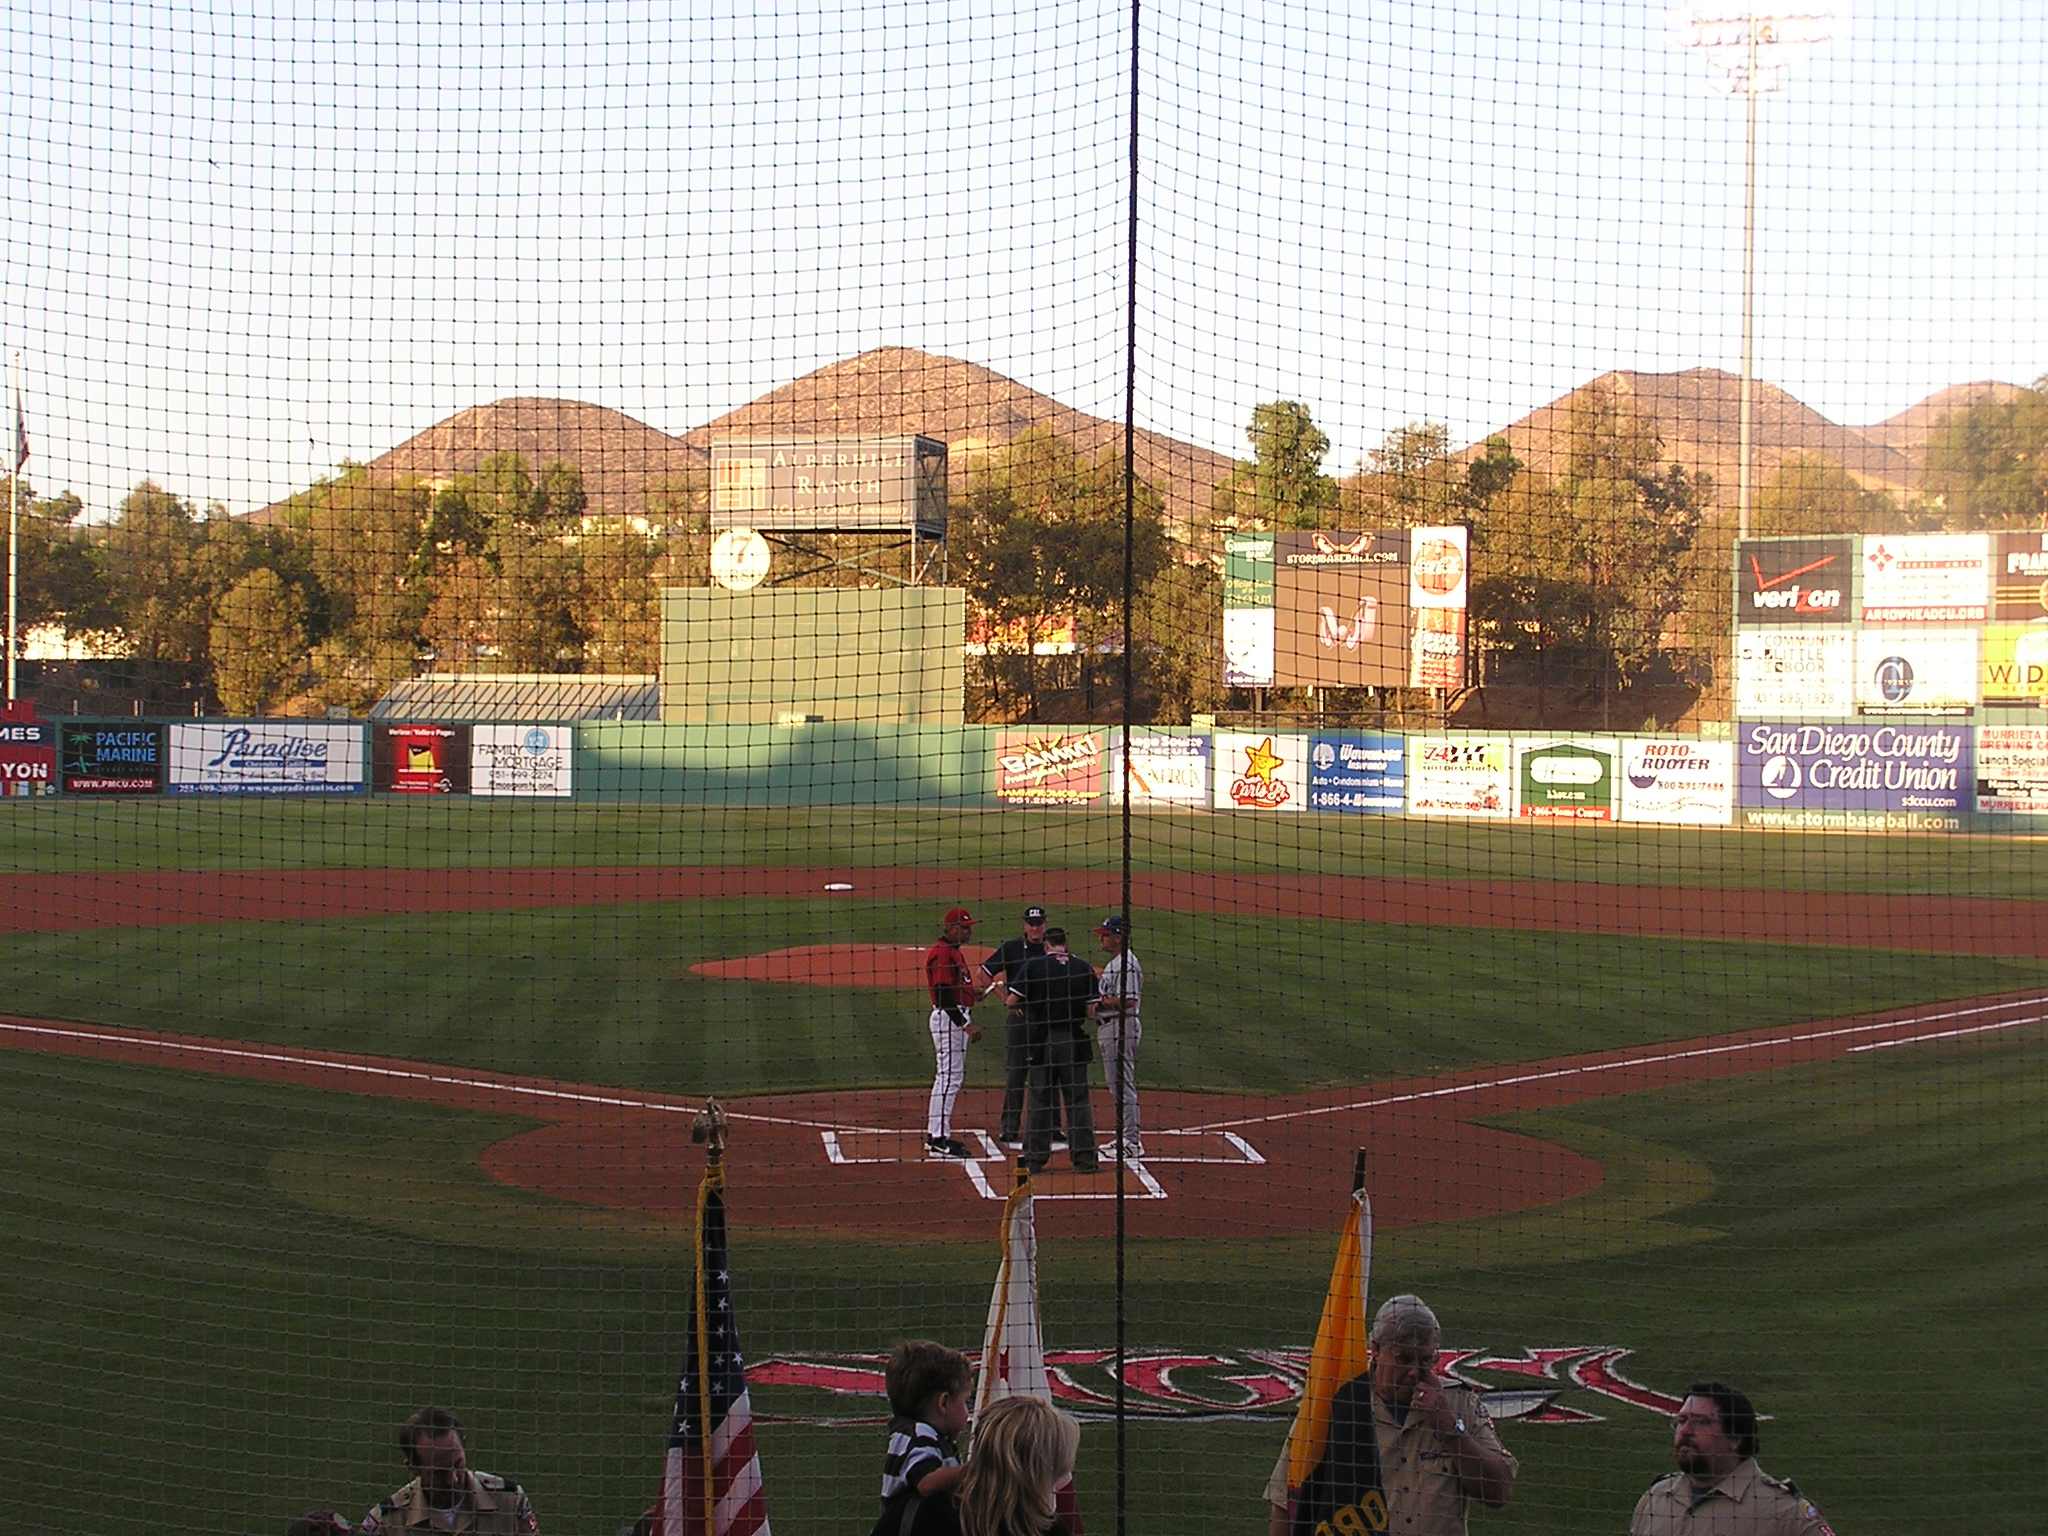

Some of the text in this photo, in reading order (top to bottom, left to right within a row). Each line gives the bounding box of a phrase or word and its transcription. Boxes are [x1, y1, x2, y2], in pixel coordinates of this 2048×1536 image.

[772, 450, 907, 469] ALBERHILL
[796, 476, 881, 494] RANCH
[1286, 552, 1398, 564] STORMBASEBALL.COM
[1753, 585, 1841, 613] verizon
[1865, 606, 1985, 621] ARROWHEADCU.ORG
[1764, 634, 1846, 646] COMMUNITY
[1702, 722, 1731, 736] 342
[1982, 730, 2041, 740] MURRIETA
[96, 732, 156, 746] PACIFIC
[1748, 726, 1961, 763] San Diego County
[1980, 740, 2033, 750] BREWING
[208, 728, 328, 766] Paradise
[479, 744, 524, 755] FAMILY
[1645, 744, 1696, 757] ROTO-
[96, 748, 156, 762] MARINE
[1979, 754, 2009, 765] Lunch
[494, 756, 563, 768] MORTGAGE
[1641, 757, 1711, 770] ROOTER
[1809, 758, 1957, 790] Credit Union
[73, 780, 153, 788] WWW.PMCU.COM
[1901, 795, 1957, 807] sdccu.com
[1747, 811, 1960, 829] www.stormbaseball.com
